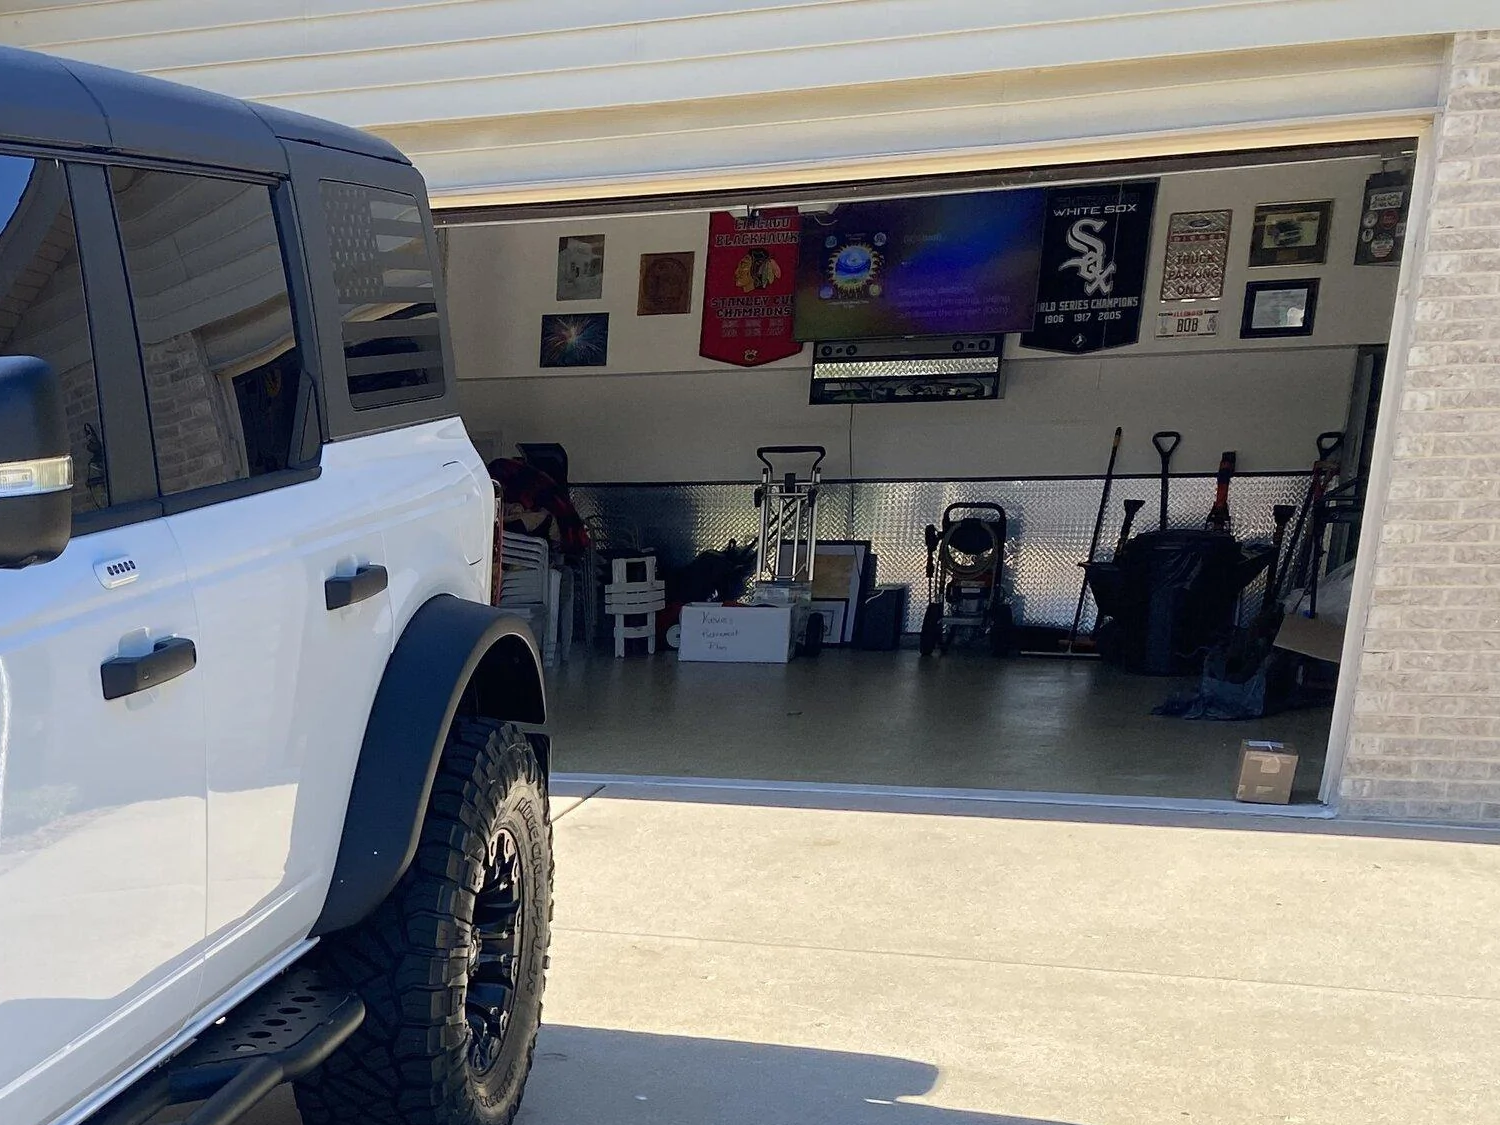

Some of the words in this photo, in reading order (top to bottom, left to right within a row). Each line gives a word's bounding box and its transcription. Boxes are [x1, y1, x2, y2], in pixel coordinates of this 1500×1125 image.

[1053, 206, 1101, 217] WHITE
[1104, 204, 1137, 214] SOX
[715, 231, 799, 246] BLACKHAWK
[1177, 253, 1216, 264] TRUCK
[1169, 268, 1220, 281] PARKING
[1177, 283, 1207, 295] ONLY
[711, 295, 769, 307] STANLEY
[1058, 300, 1089, 311] SERIES
[1090, 297, 1139, 309] CHAMPIONS
[716, 306, 792, 318] CHAMPIONS
[1044, 315, 1064, 324] 1906
[1074, 313, 1092, 322] 1917
[1098, 311, 1122, 321] 2005
[1176, 318, 1199, 332] BOB
